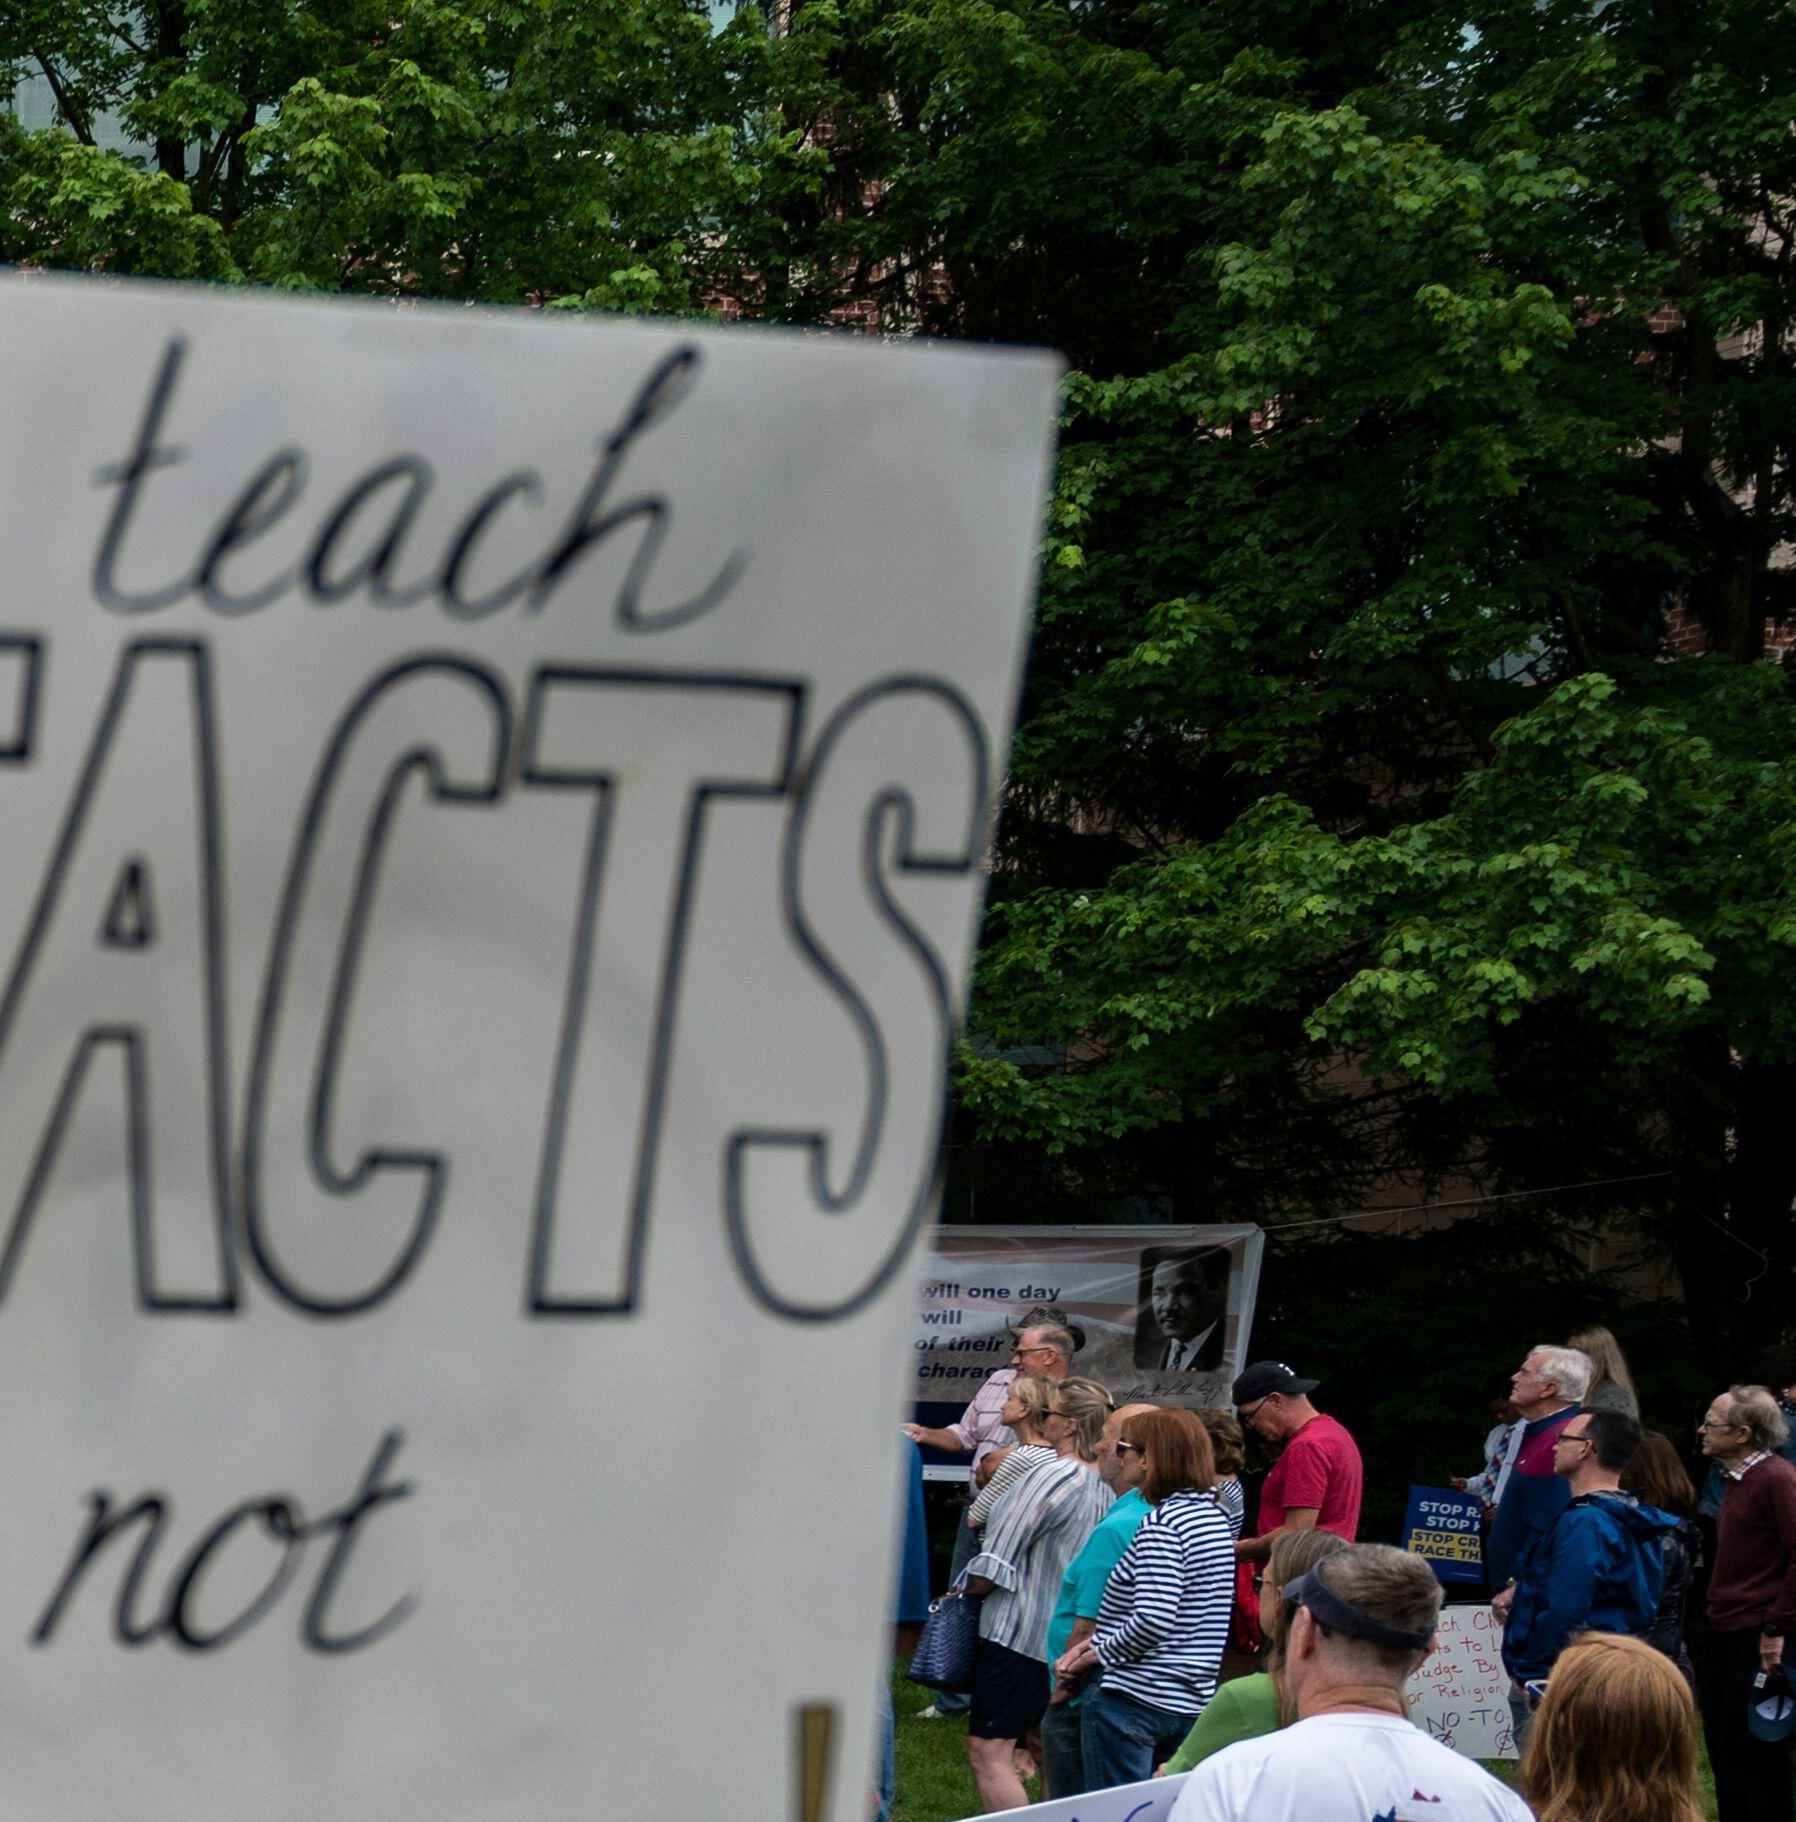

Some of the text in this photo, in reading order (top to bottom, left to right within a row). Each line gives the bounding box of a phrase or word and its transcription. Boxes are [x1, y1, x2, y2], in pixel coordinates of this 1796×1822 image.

[90, 330, 758, 635] teach
[919, 1283, 1062, 1302] will one day
[920, 1310, 962, 1325] will
[915, 1335, 938, 1351] of
[947, 1335, 1005, 1352] their
[917, 1362, 1012, 1379] charac
[1418, 1500, 1464, 1516] STOP
[1426, 1515, 1470, 1530] STOP
[28, 1427, 422, 1655] not
[1414, 1531, 1481, 1548] STOP CR
[1414, 1544, 1456, 1558] RACE
[1471, 1610, 1498, 1631] Ch
[1459, 1636, 1483, 1653] to
[1471, 1658, 1500, 1682] By
[1431, 1683, 1506, 1703] Religion
[1426, 1711, 1461, 1733] NO
